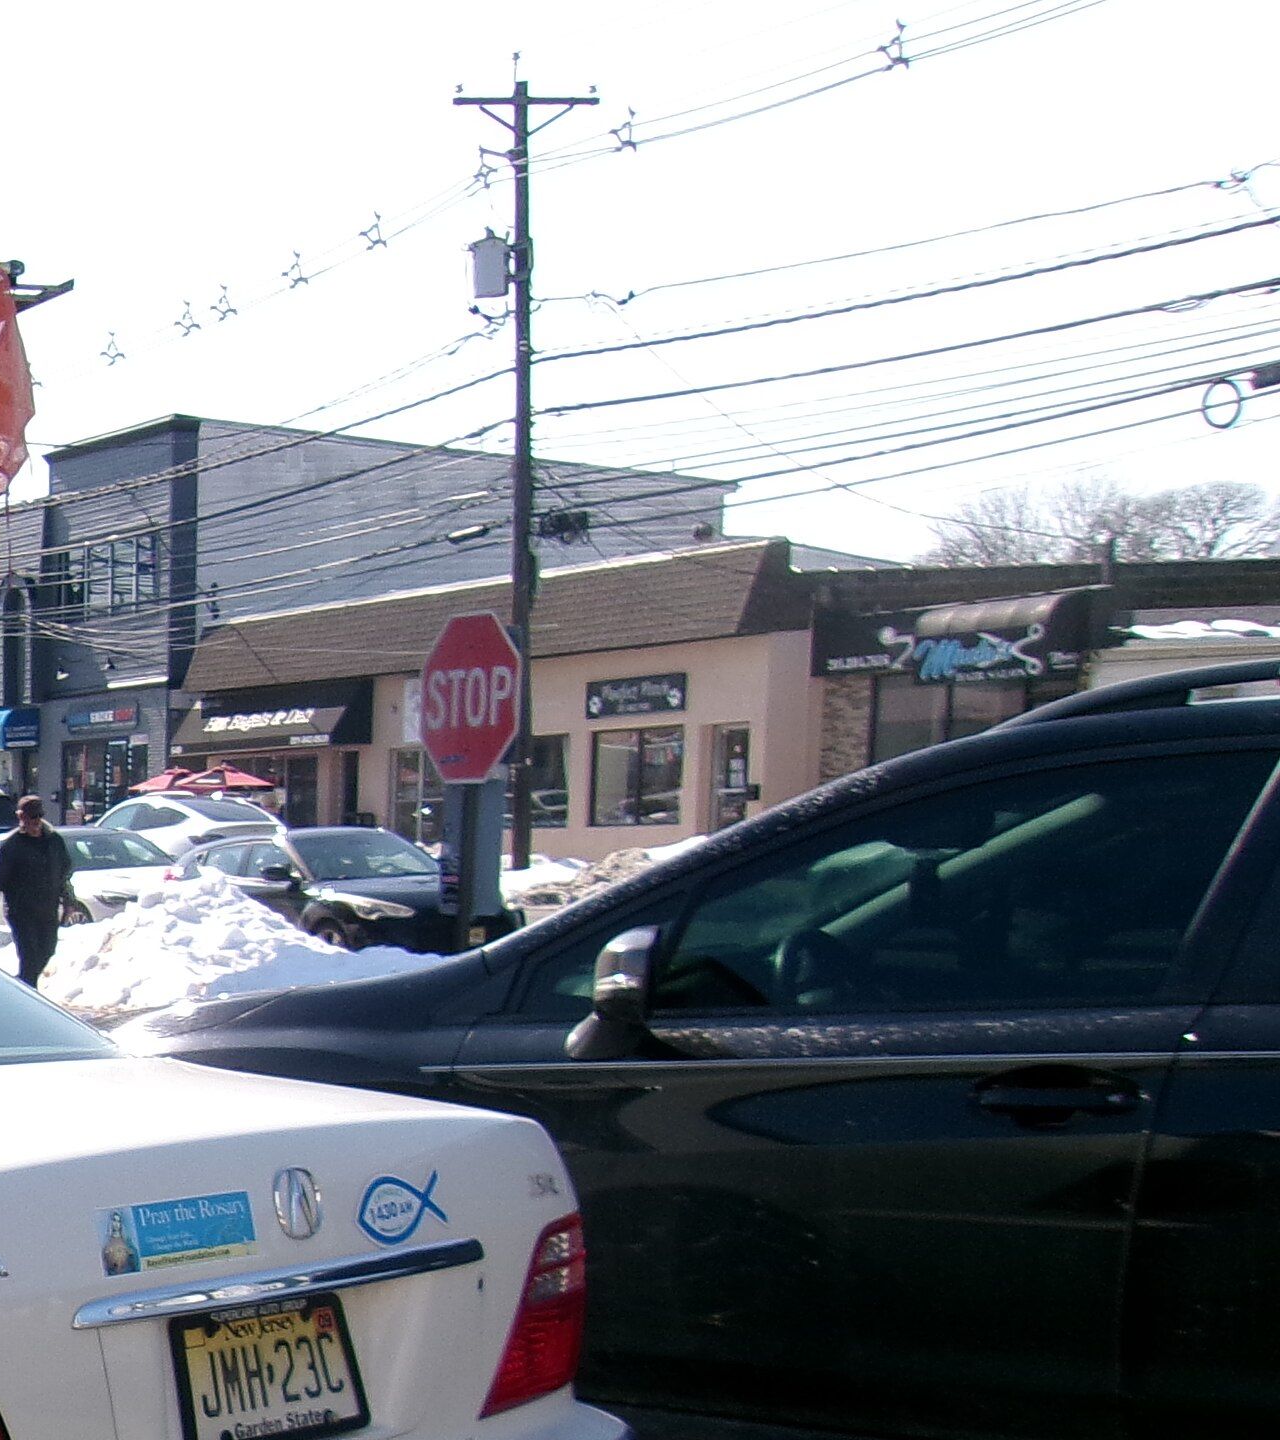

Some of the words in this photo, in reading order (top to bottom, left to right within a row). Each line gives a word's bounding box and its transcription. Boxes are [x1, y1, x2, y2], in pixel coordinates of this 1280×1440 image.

[427, 666, 513, 729] STOP
[139, 1206, 171, 1227] Pray
[174, 1203, 197, 1220] the
[198, 1200, 246, 1219] Rosary
[223, 1319, 255, 1341] New
[258, 1312, 295, 1338] Jersey
[235, 1418, 283, 1439] Garden
[286, 1409, 321, 1427] State
